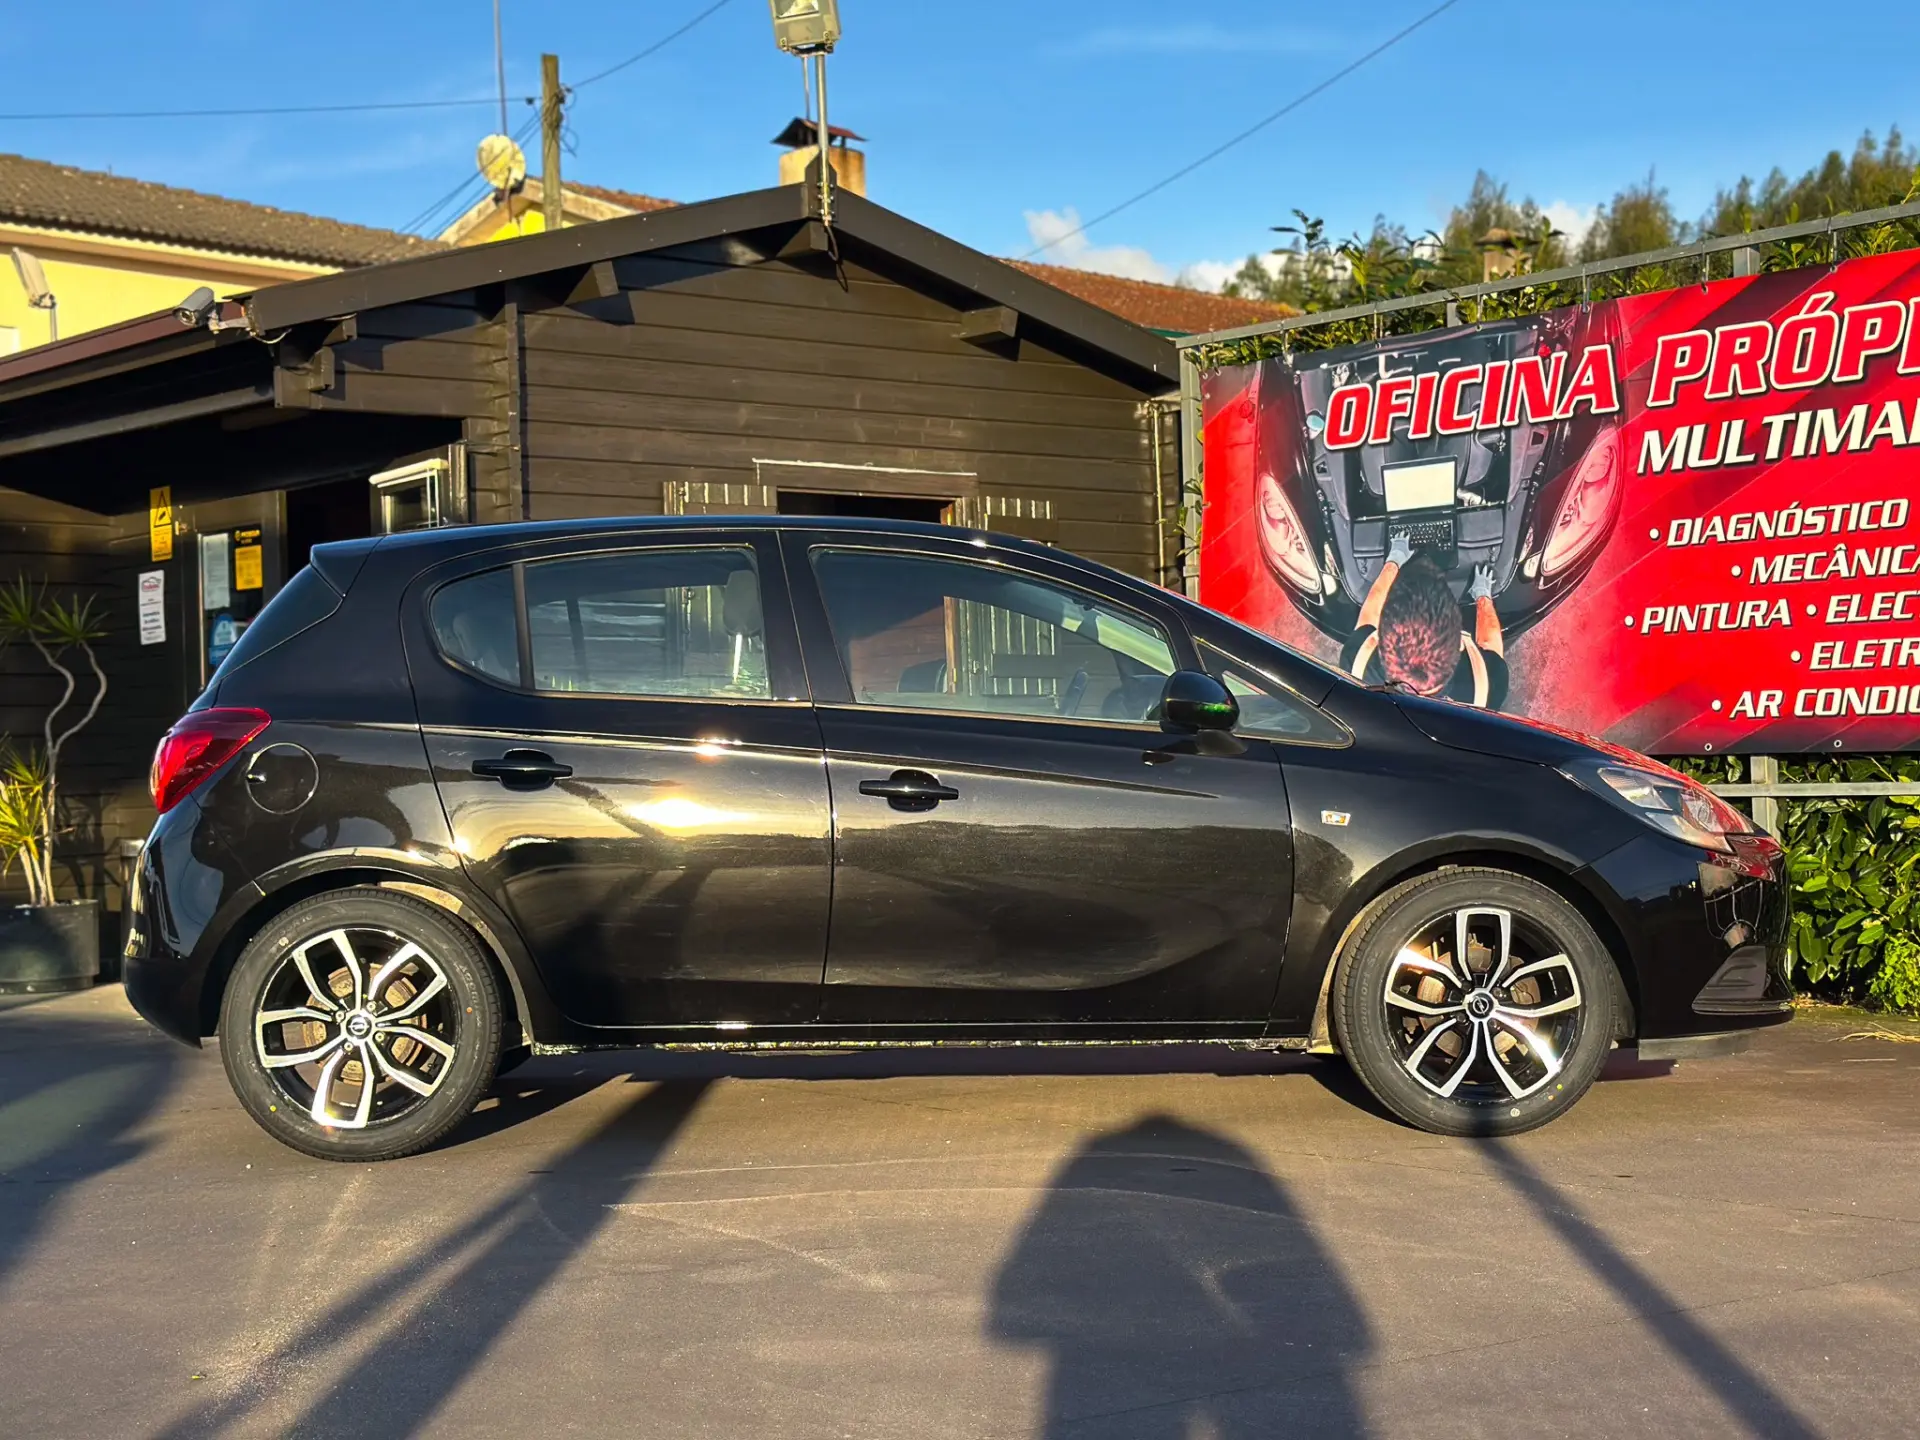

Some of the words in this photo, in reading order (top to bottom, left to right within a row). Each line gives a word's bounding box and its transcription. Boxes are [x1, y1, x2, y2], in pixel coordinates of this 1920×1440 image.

[1324, 343, 1620, 450] OFICINA
[1666, 498, 1909, 547] DIAGNÓSTICO
[1640, 598, 1791, 634] PINTURA
[1825, 590, 1920, 624] ELEC
[1729, 689, 1783, 718] AR
